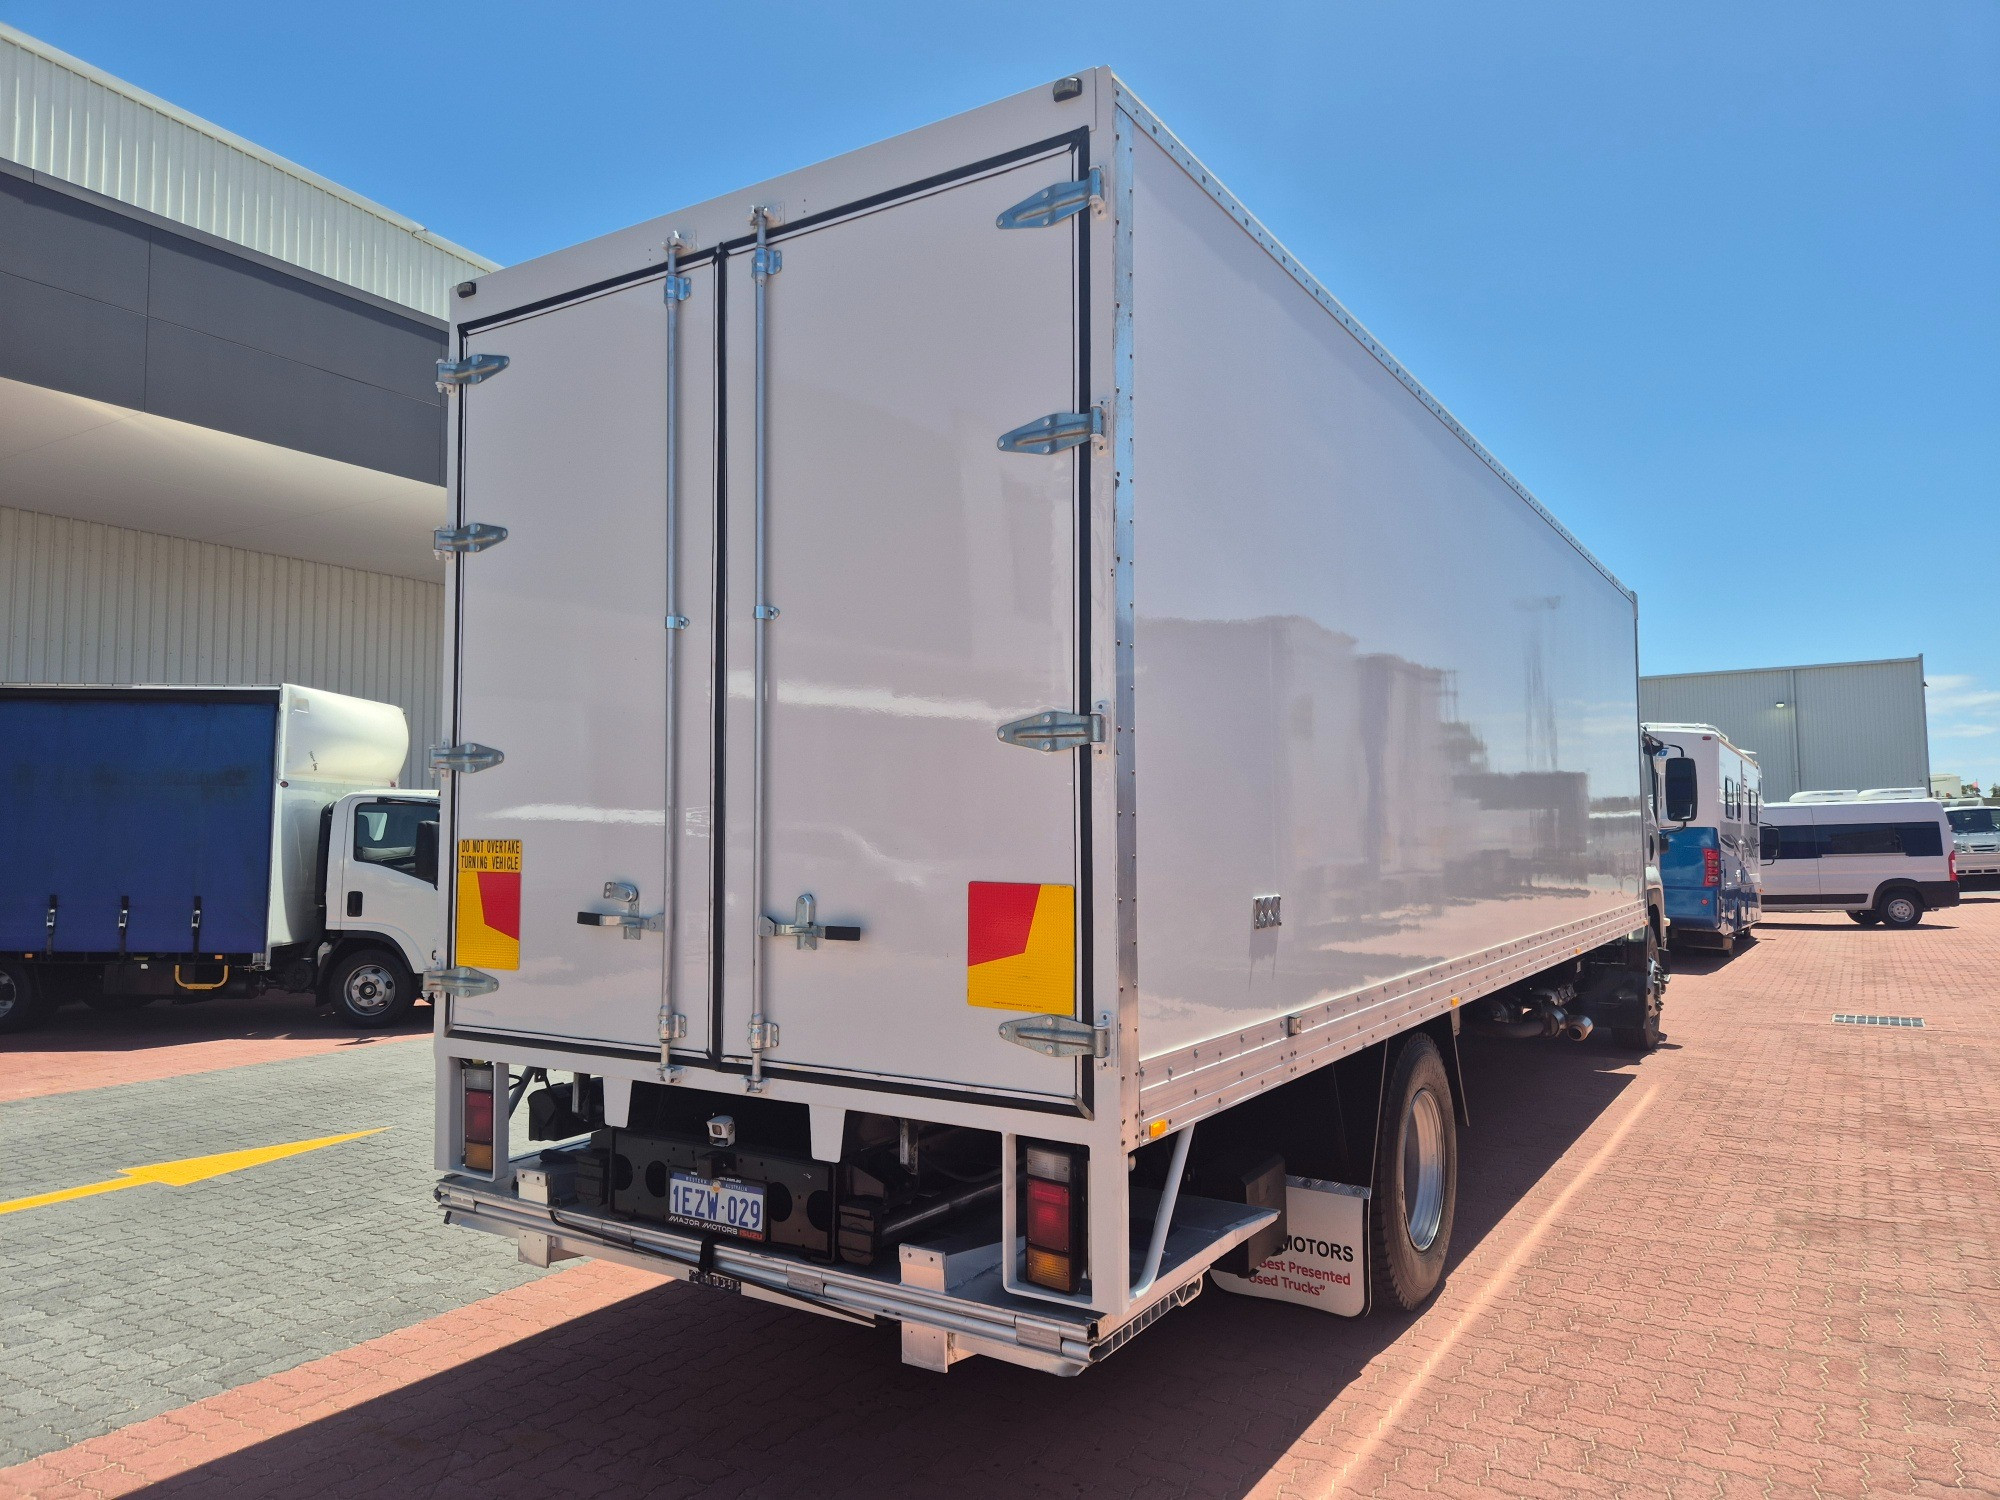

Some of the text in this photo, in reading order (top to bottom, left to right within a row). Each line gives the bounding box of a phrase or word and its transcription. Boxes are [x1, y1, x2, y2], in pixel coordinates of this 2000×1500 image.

[461, 840, 520, 854] DO NOT OVERTAKE
[461, 855, 519, 870] TURNING VEHICLE
[685, 1175, 708, 1185] WESTERN
[724, 1183, 748, 1192] AUSTRALIA
[669, 1215, 763, 1240] MAJOR MOTORS ISUZU
[1288, 1261, 1351, 1286] Presented
